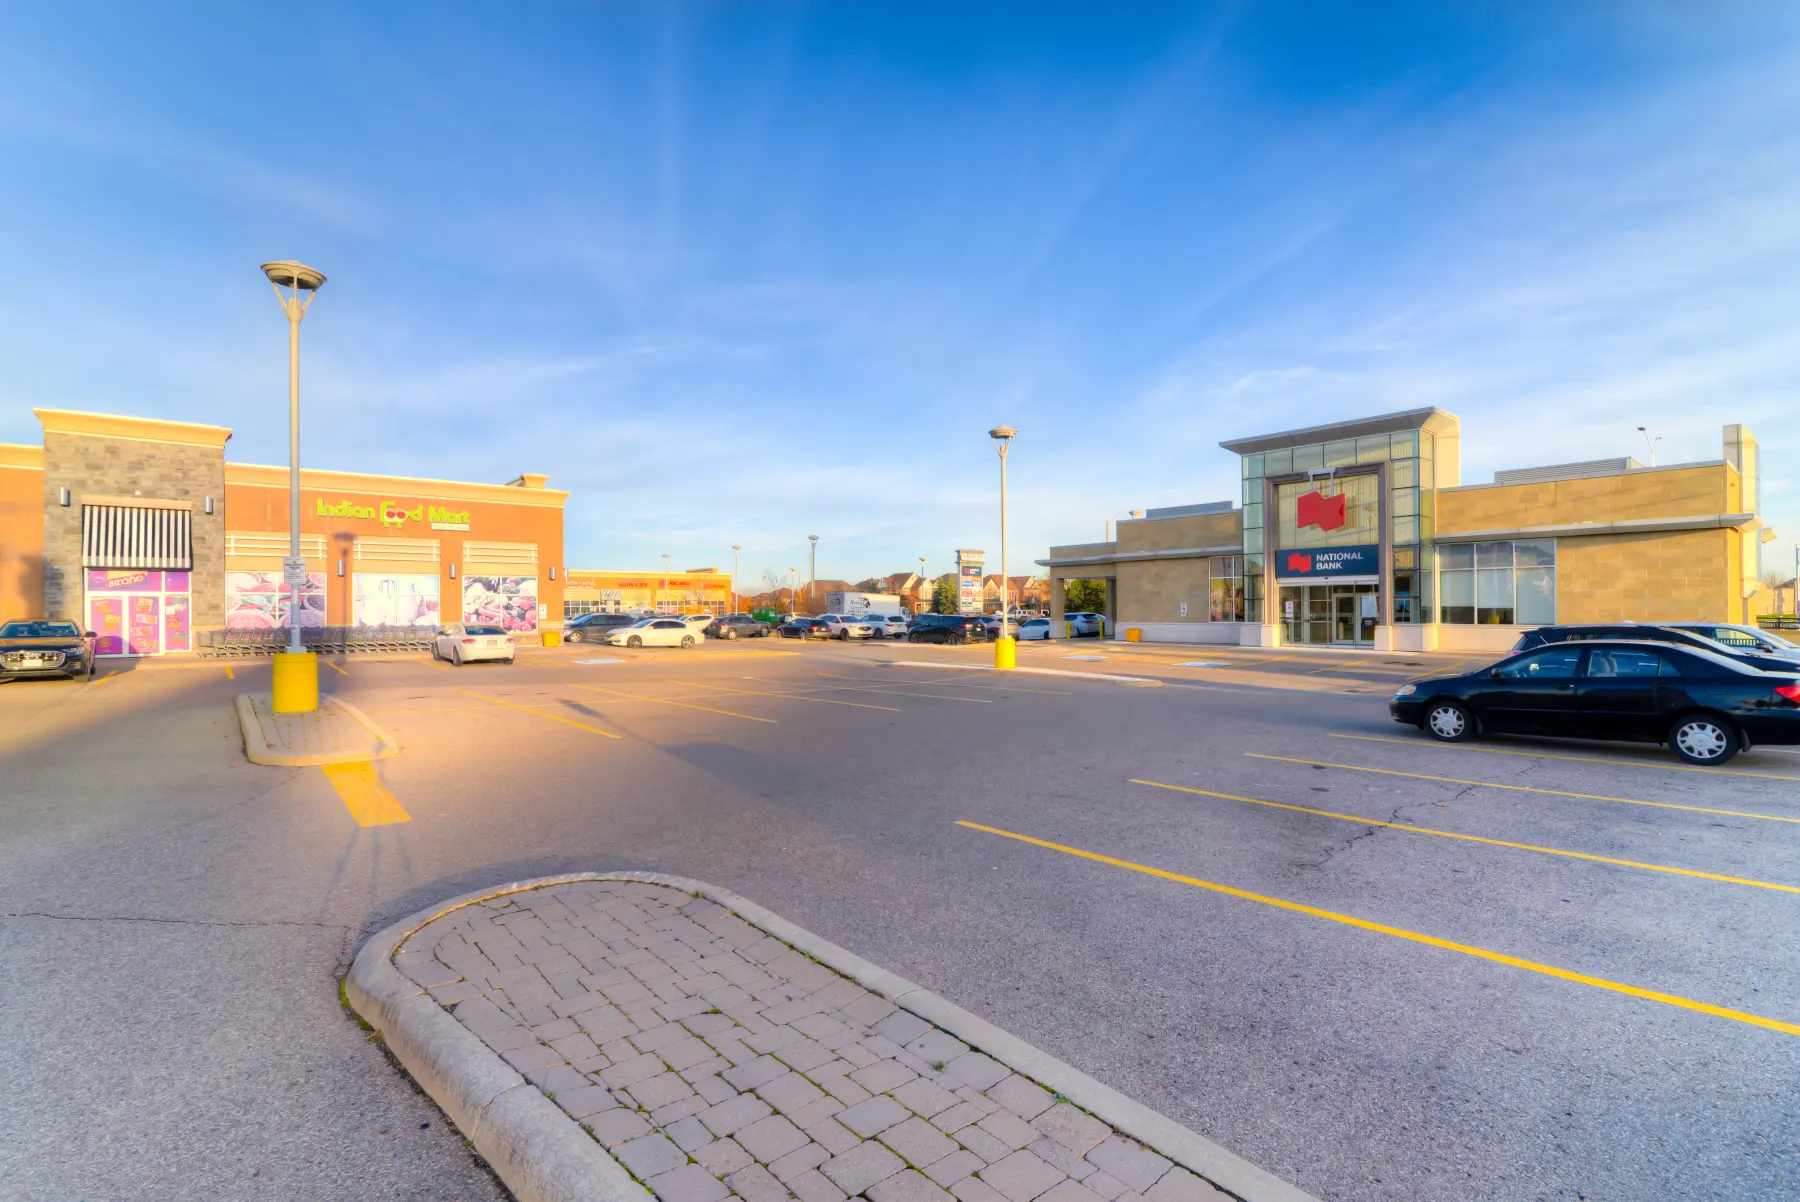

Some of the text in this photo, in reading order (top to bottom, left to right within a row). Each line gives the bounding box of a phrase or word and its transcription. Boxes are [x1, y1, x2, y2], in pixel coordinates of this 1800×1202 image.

[317, 498, 376, 519] Indian
[428, 505, 470, 524] Mart
[1316, 552, 1364, 562] NATIONAL
[1316, 561, 1343, 571] BANK
